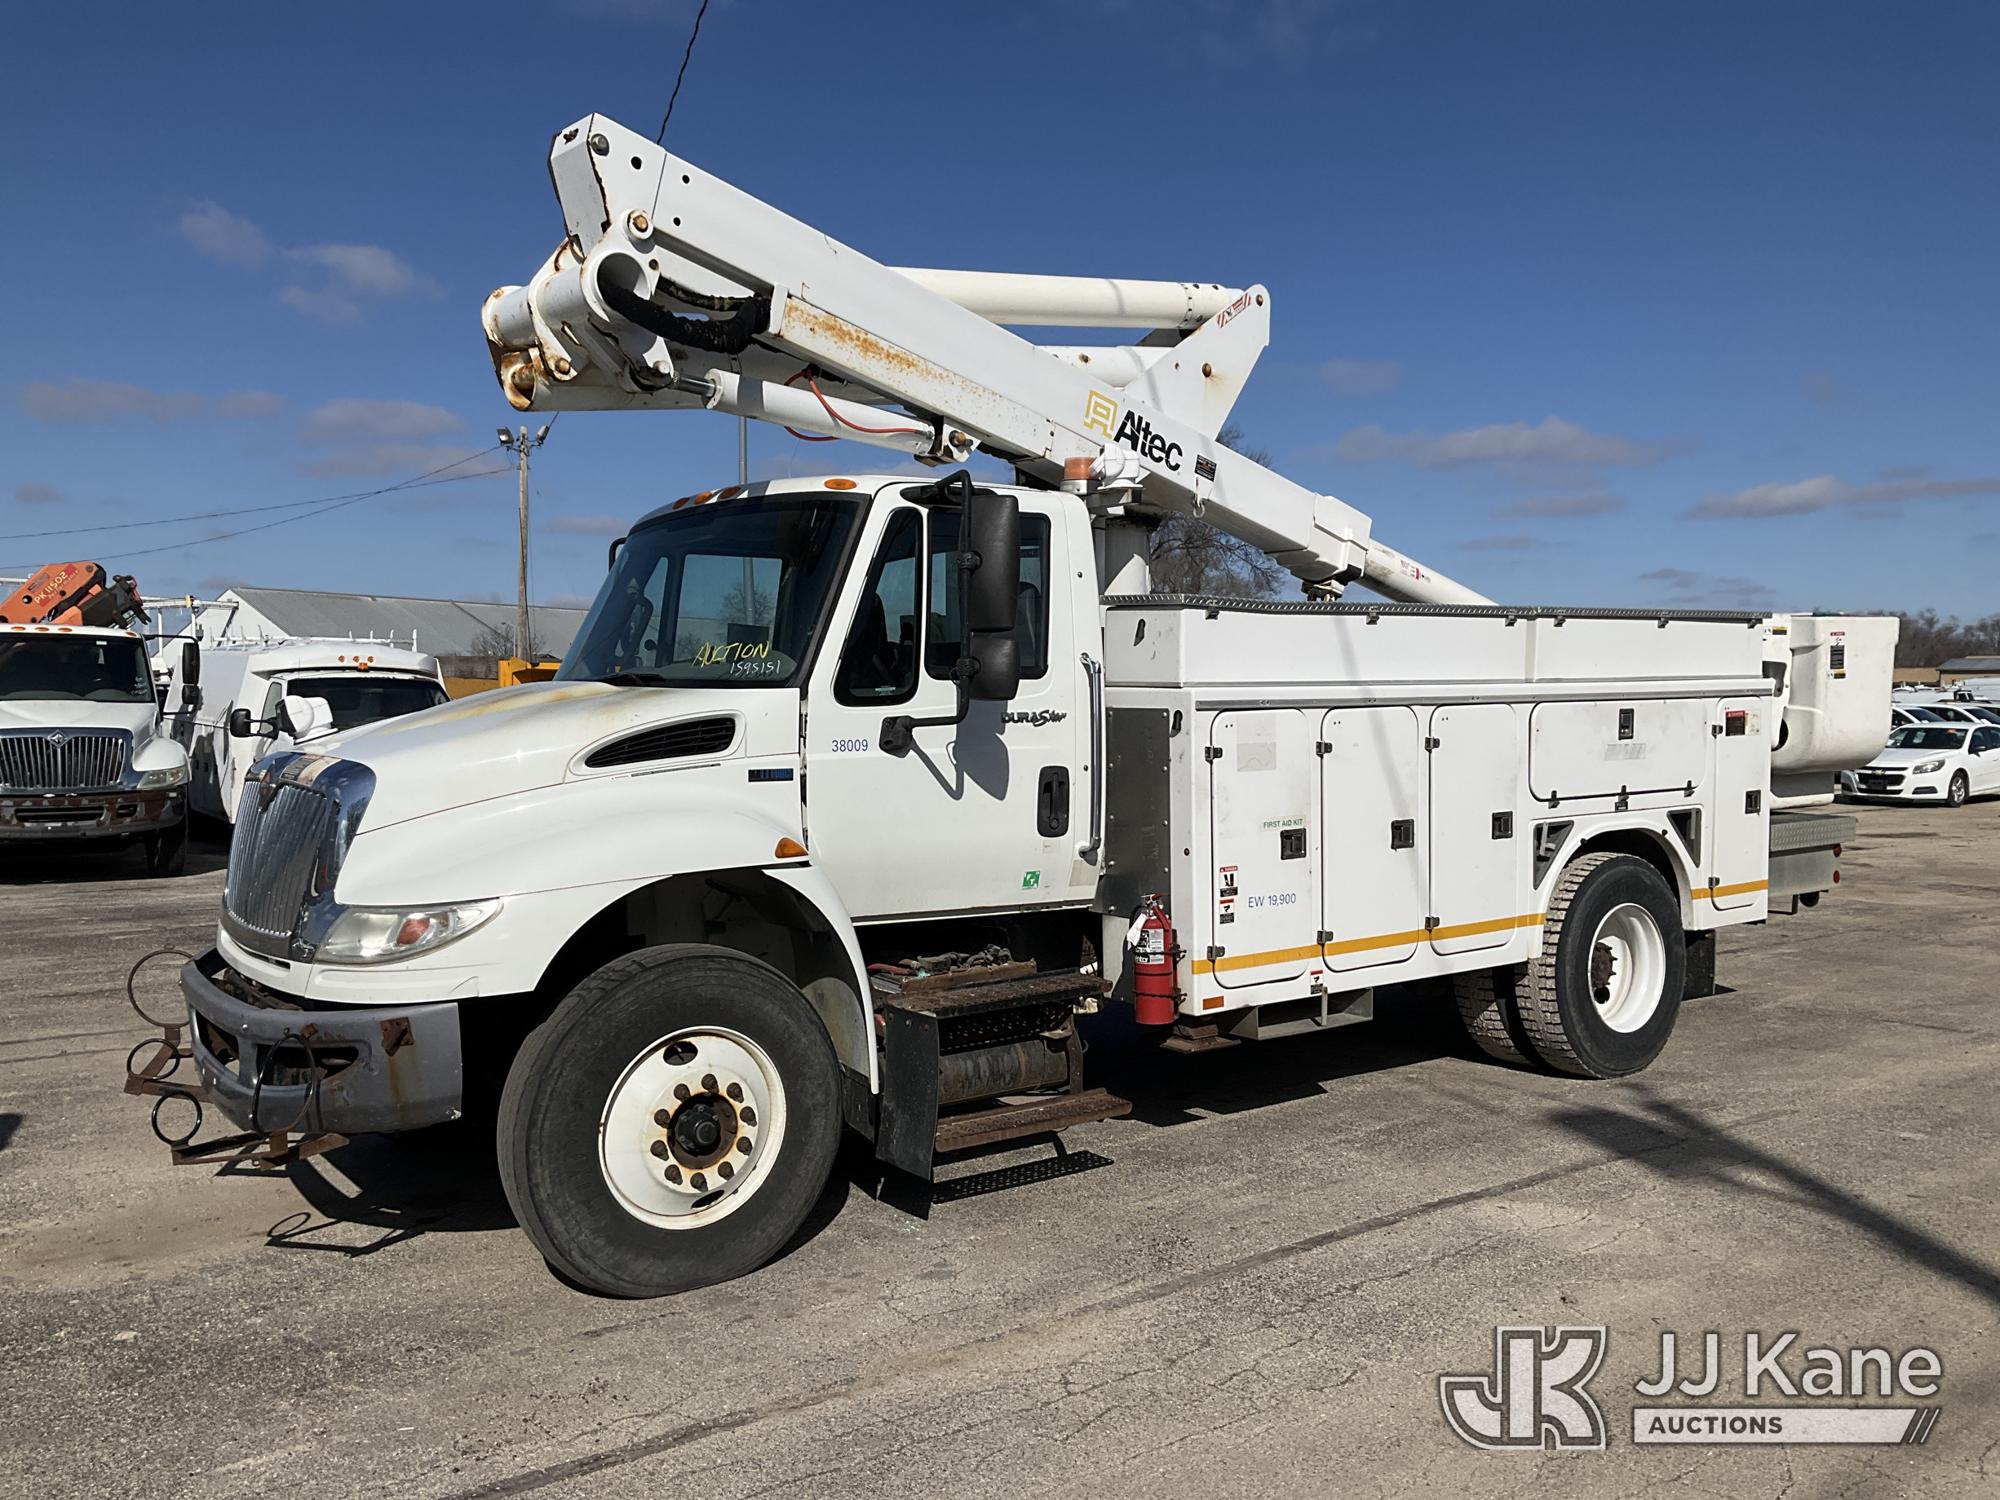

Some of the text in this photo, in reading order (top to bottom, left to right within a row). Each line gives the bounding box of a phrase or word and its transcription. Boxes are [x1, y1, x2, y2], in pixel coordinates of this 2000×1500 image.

[1113, 409, 1183, 472] Altec
[33, 590, 46, 604] PK
[692, 640, 770, 668] AUCTION
[831, 739, 868, 752] 38009
[1263, 818, 1303, 829] FIRST AID KIT
[1248, 892, 1297, 908] EW 19,900
